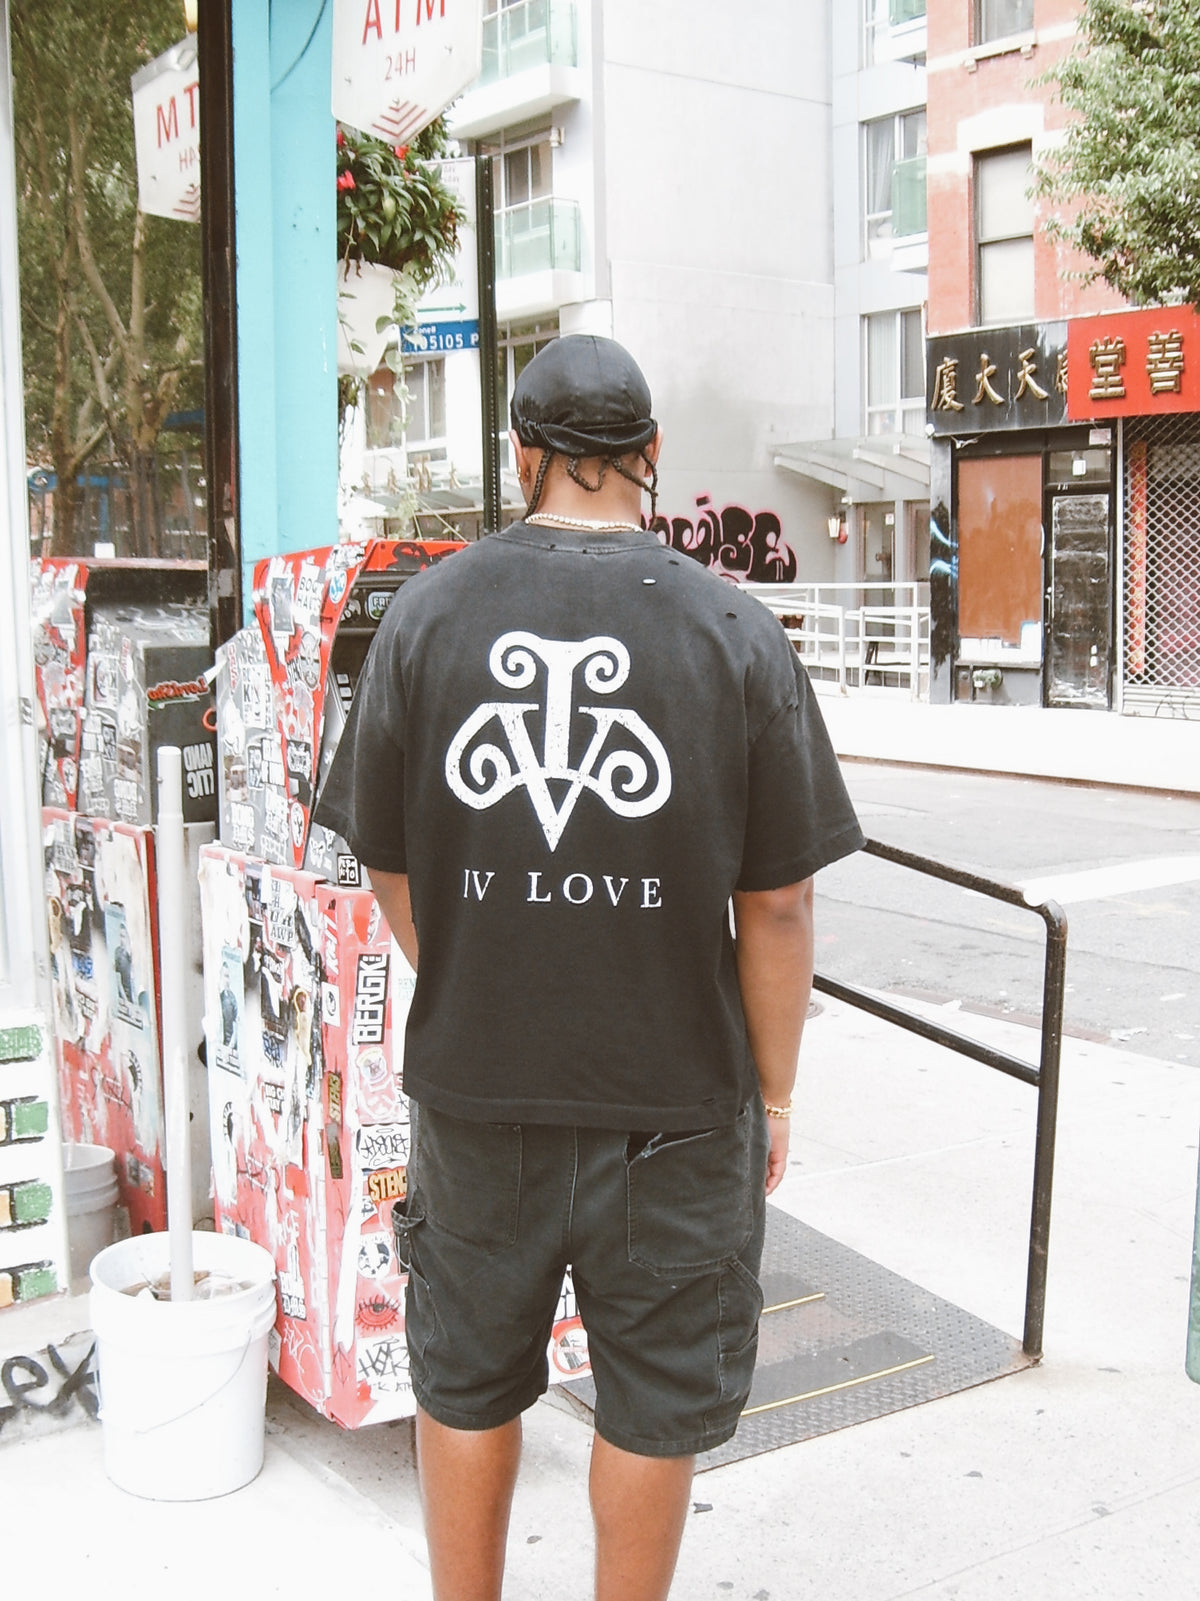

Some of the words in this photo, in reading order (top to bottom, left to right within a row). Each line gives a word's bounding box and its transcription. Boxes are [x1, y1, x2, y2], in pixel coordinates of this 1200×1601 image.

[385, 48, 416, 81] 24H
[464, 869, 495, 902] IV
[526, 871, 663, 909] LOVE
